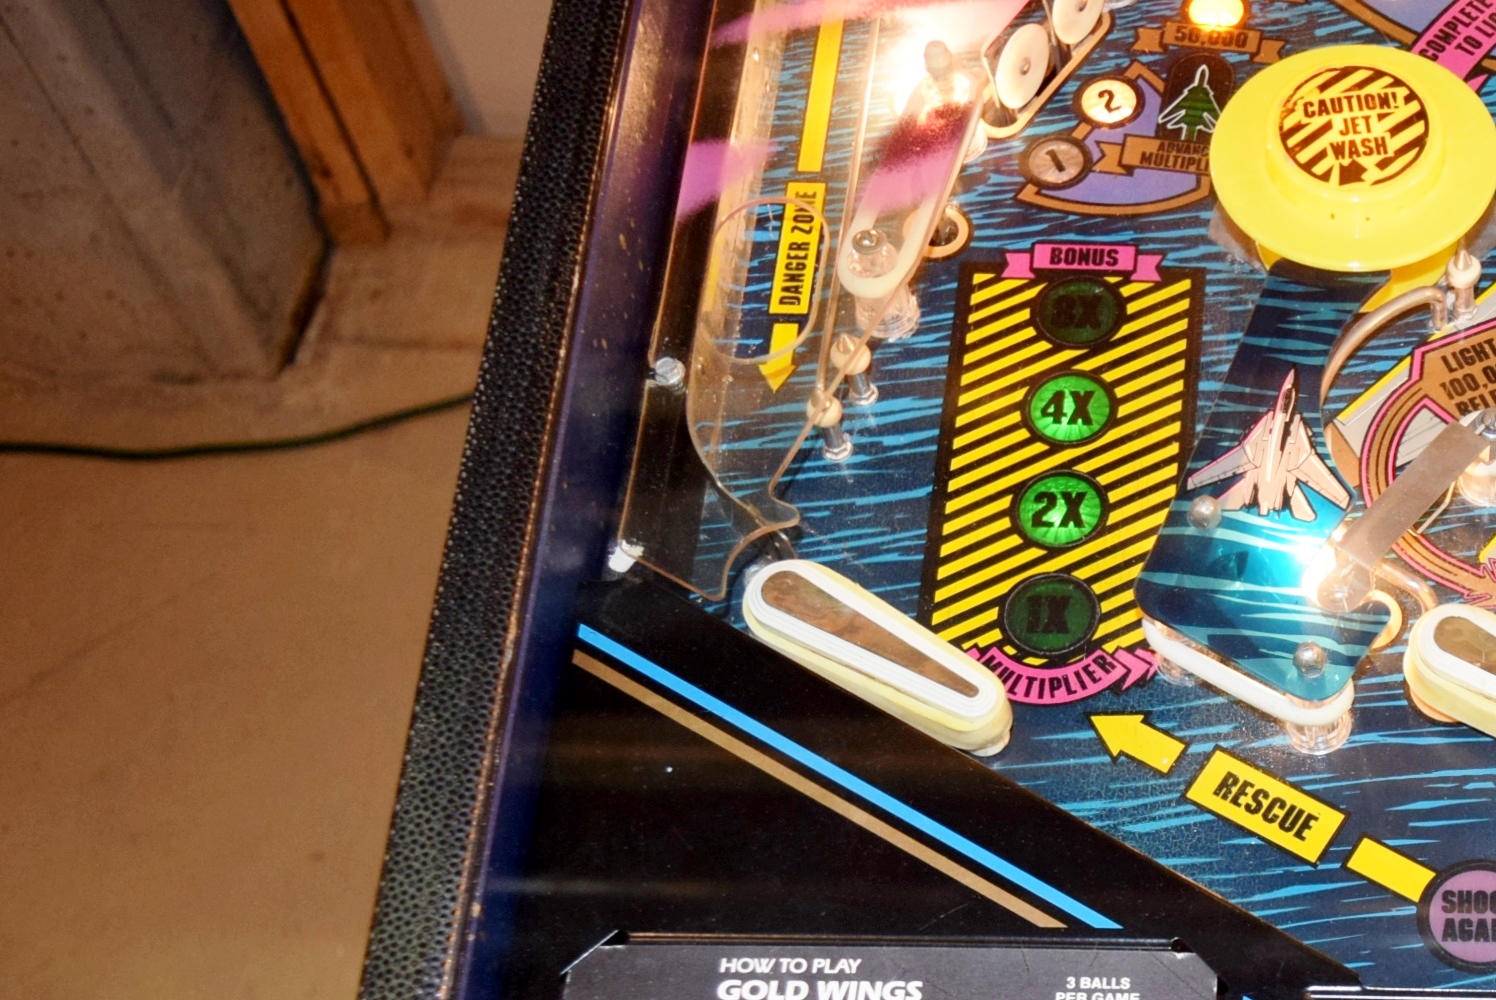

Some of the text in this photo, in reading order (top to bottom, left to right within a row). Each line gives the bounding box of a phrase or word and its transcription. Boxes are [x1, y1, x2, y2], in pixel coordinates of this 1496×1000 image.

[1454, 36, 1483, 57] TO
[1097, 89, 1122, 114] 2
[1302, 91, 1399, 118] CAUTION!
[1339, 115, 1372, 137] JET
[1045, 148, 1066, 173] 1
[1329, 136, 1389, 161] WASH
[1048, 247, 1120, 268] BONUS
[778, 241, 811, 306] DANGER
[1040, 390, 1097, 426] 4X
[1031, 490, 1087, 529] 2X
[1212, 770, 1320, 843] RESCUE
[719, 958, 862, 973] HOW TO PLAY
[717, 980, 808, 1000] GOLD
[1066, 977, 1130, 989] 3 BALLS
